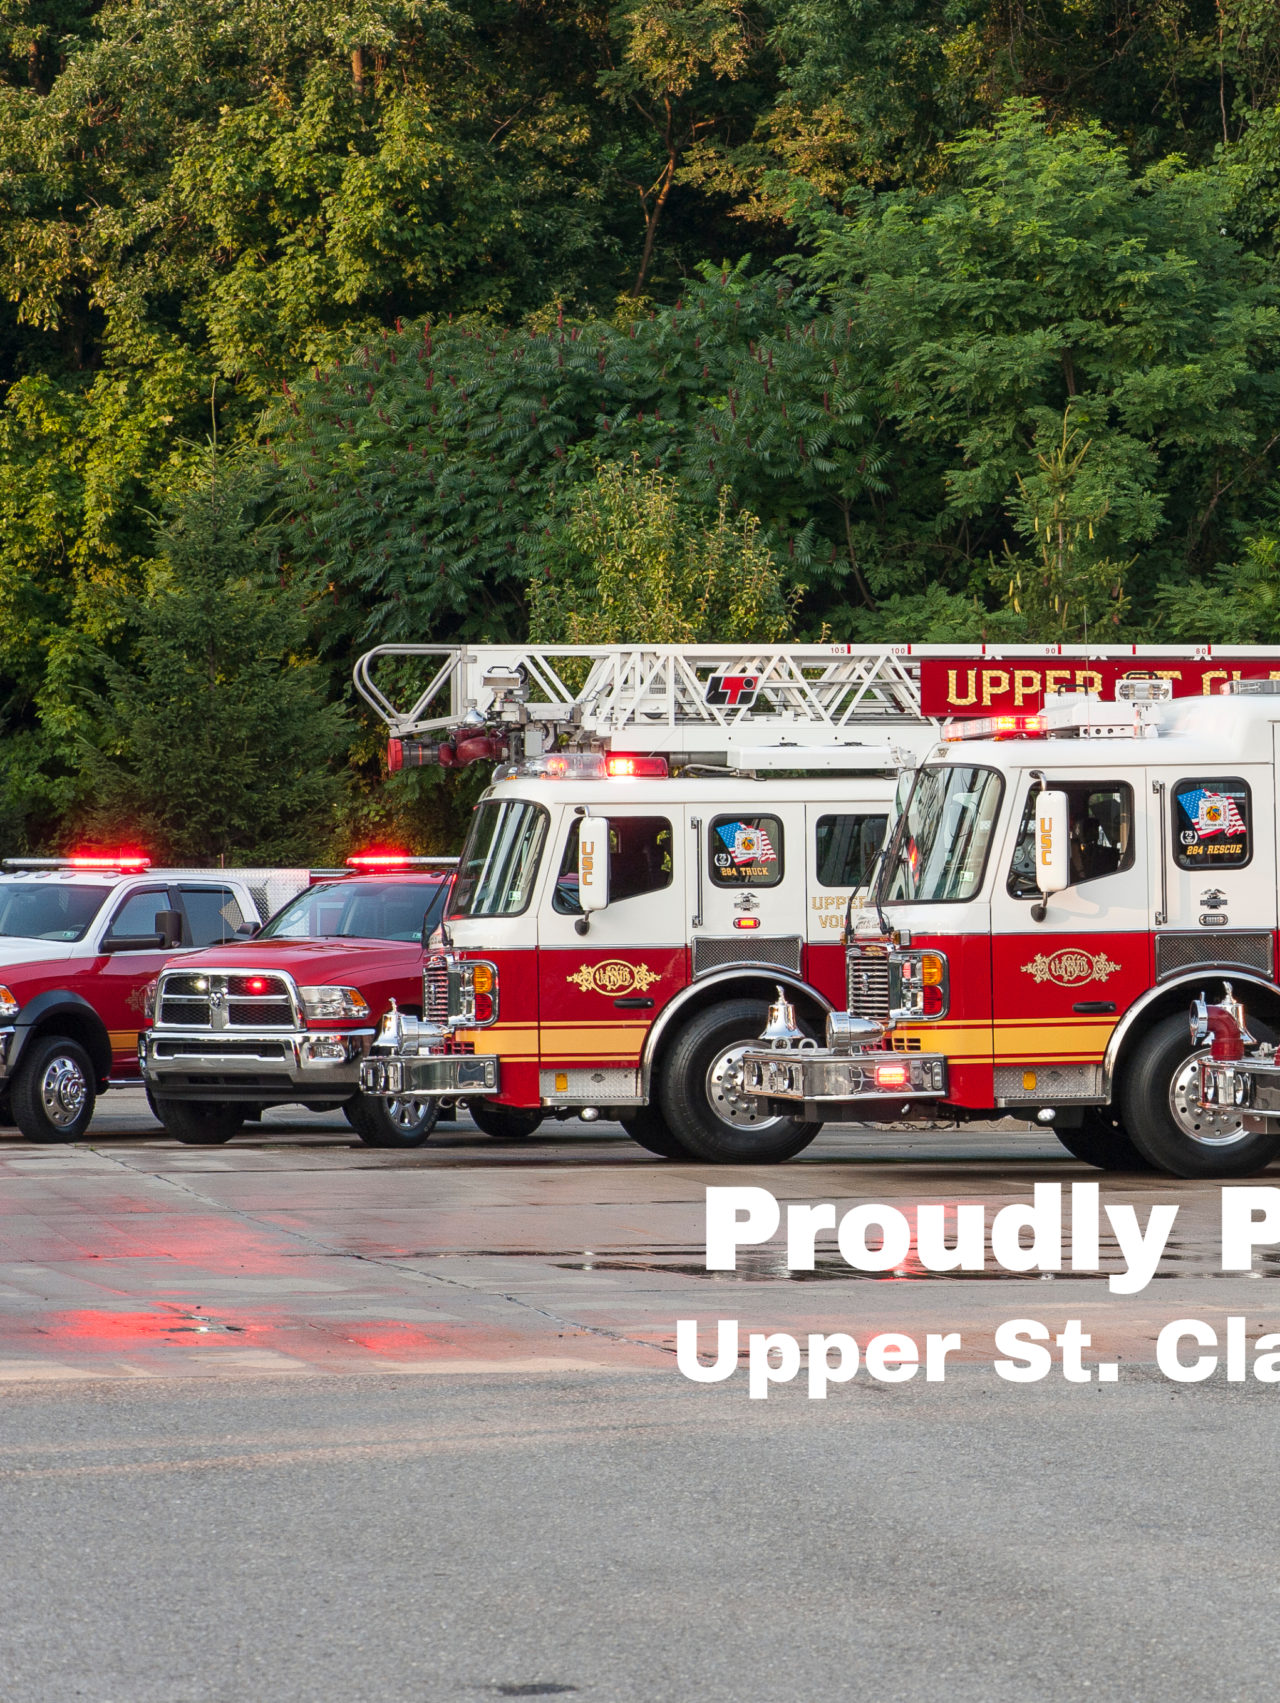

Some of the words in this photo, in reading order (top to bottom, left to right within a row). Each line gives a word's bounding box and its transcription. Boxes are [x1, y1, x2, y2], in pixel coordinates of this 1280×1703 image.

[1040, 817, 1052, 866] USC
[1186, 845, 1205, 856] 284
[1207, 844, 1243, 855] RESCUE
[581, 841, 595, 886] USC
[740, 867, 769, 876] TRUCK
